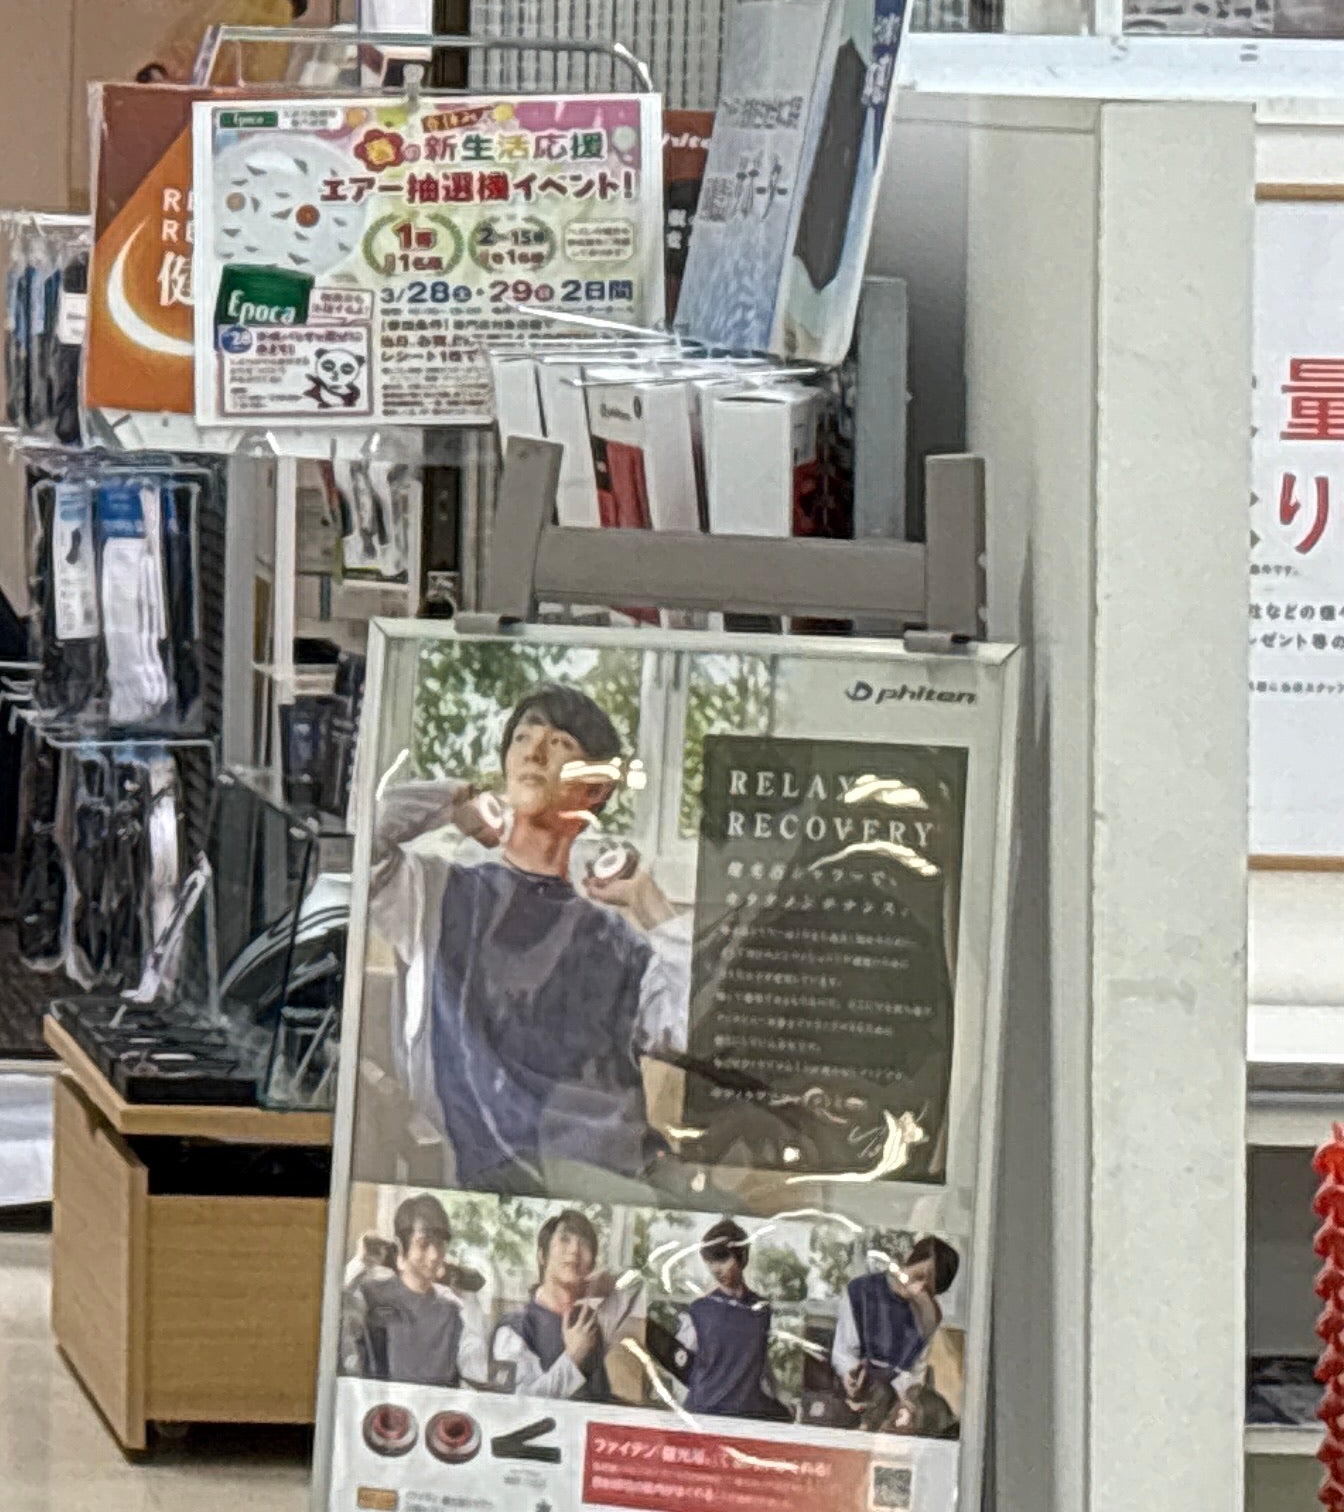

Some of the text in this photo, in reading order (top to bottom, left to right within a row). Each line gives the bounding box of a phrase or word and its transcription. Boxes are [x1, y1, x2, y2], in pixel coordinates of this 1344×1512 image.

[321, 171, 633, 202] エアー抽選機イベント!
[875, 685, 976, 705] phiten
[727, 810, 934, 849] RECOVERY
